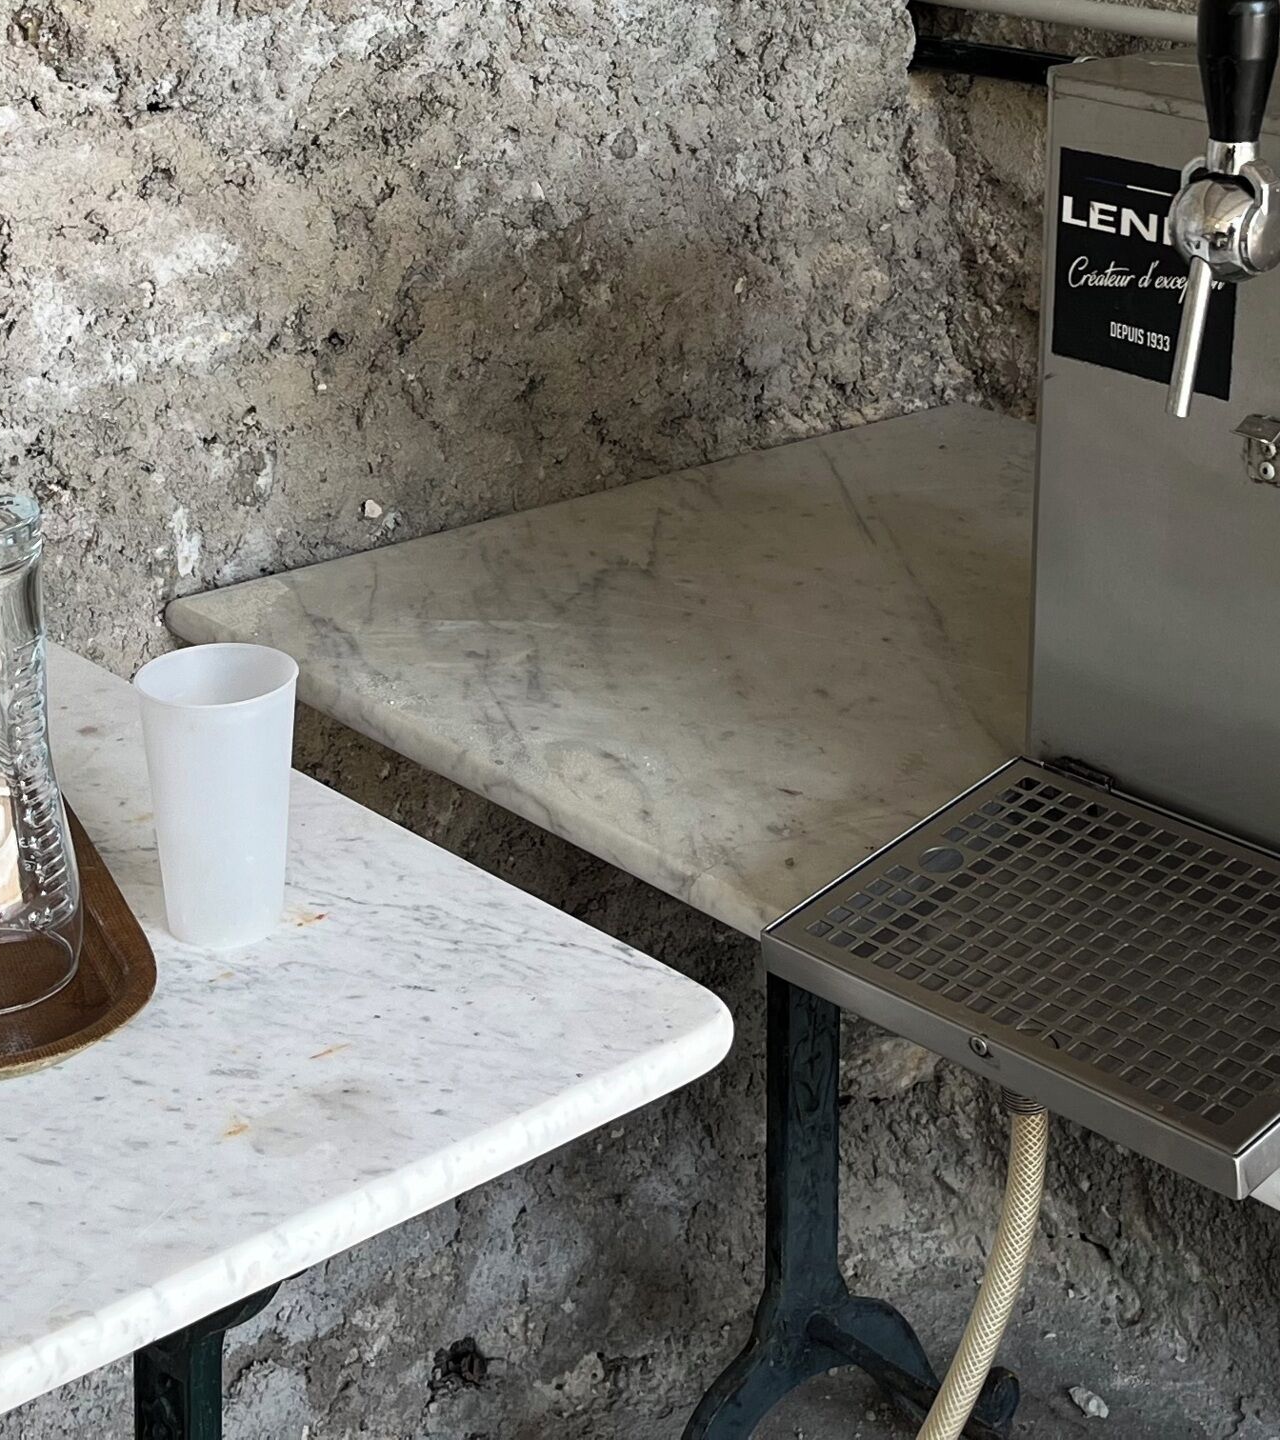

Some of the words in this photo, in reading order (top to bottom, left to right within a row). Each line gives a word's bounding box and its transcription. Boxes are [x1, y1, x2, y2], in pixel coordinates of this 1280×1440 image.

[1061, 195, 1172, 246] LEN
[1068, 255, 1136, 288] Créateur
[1110, 321, 1145, 345] DEPUIS
[1146, 331, 1171, 352] 1933
